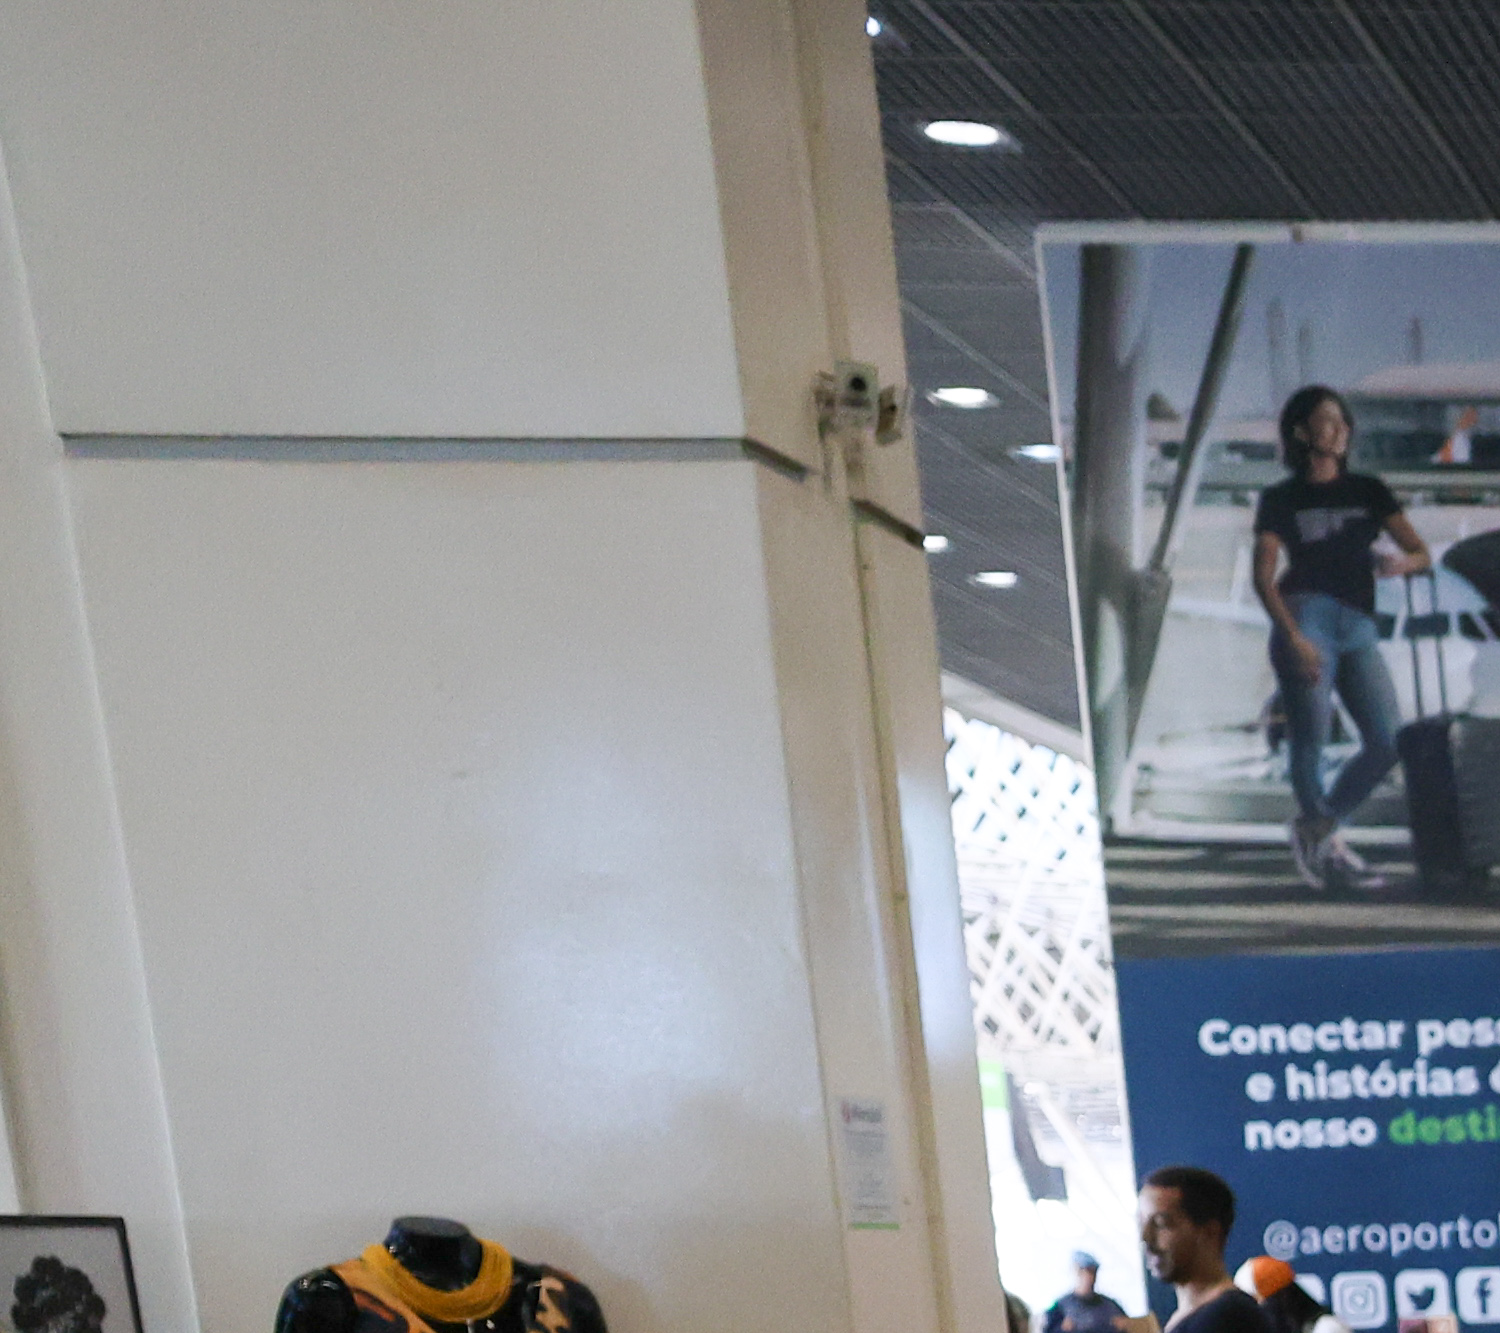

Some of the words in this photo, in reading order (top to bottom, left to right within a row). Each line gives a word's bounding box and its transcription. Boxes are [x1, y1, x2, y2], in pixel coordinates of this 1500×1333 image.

[1198, 1018, 1404, 1056] Conectar
[1246, 1073, 1275, 1102] e
[1286, 1058, 1480, 1100] histórias
[1245, 1117, 1378, 1150] nosso
